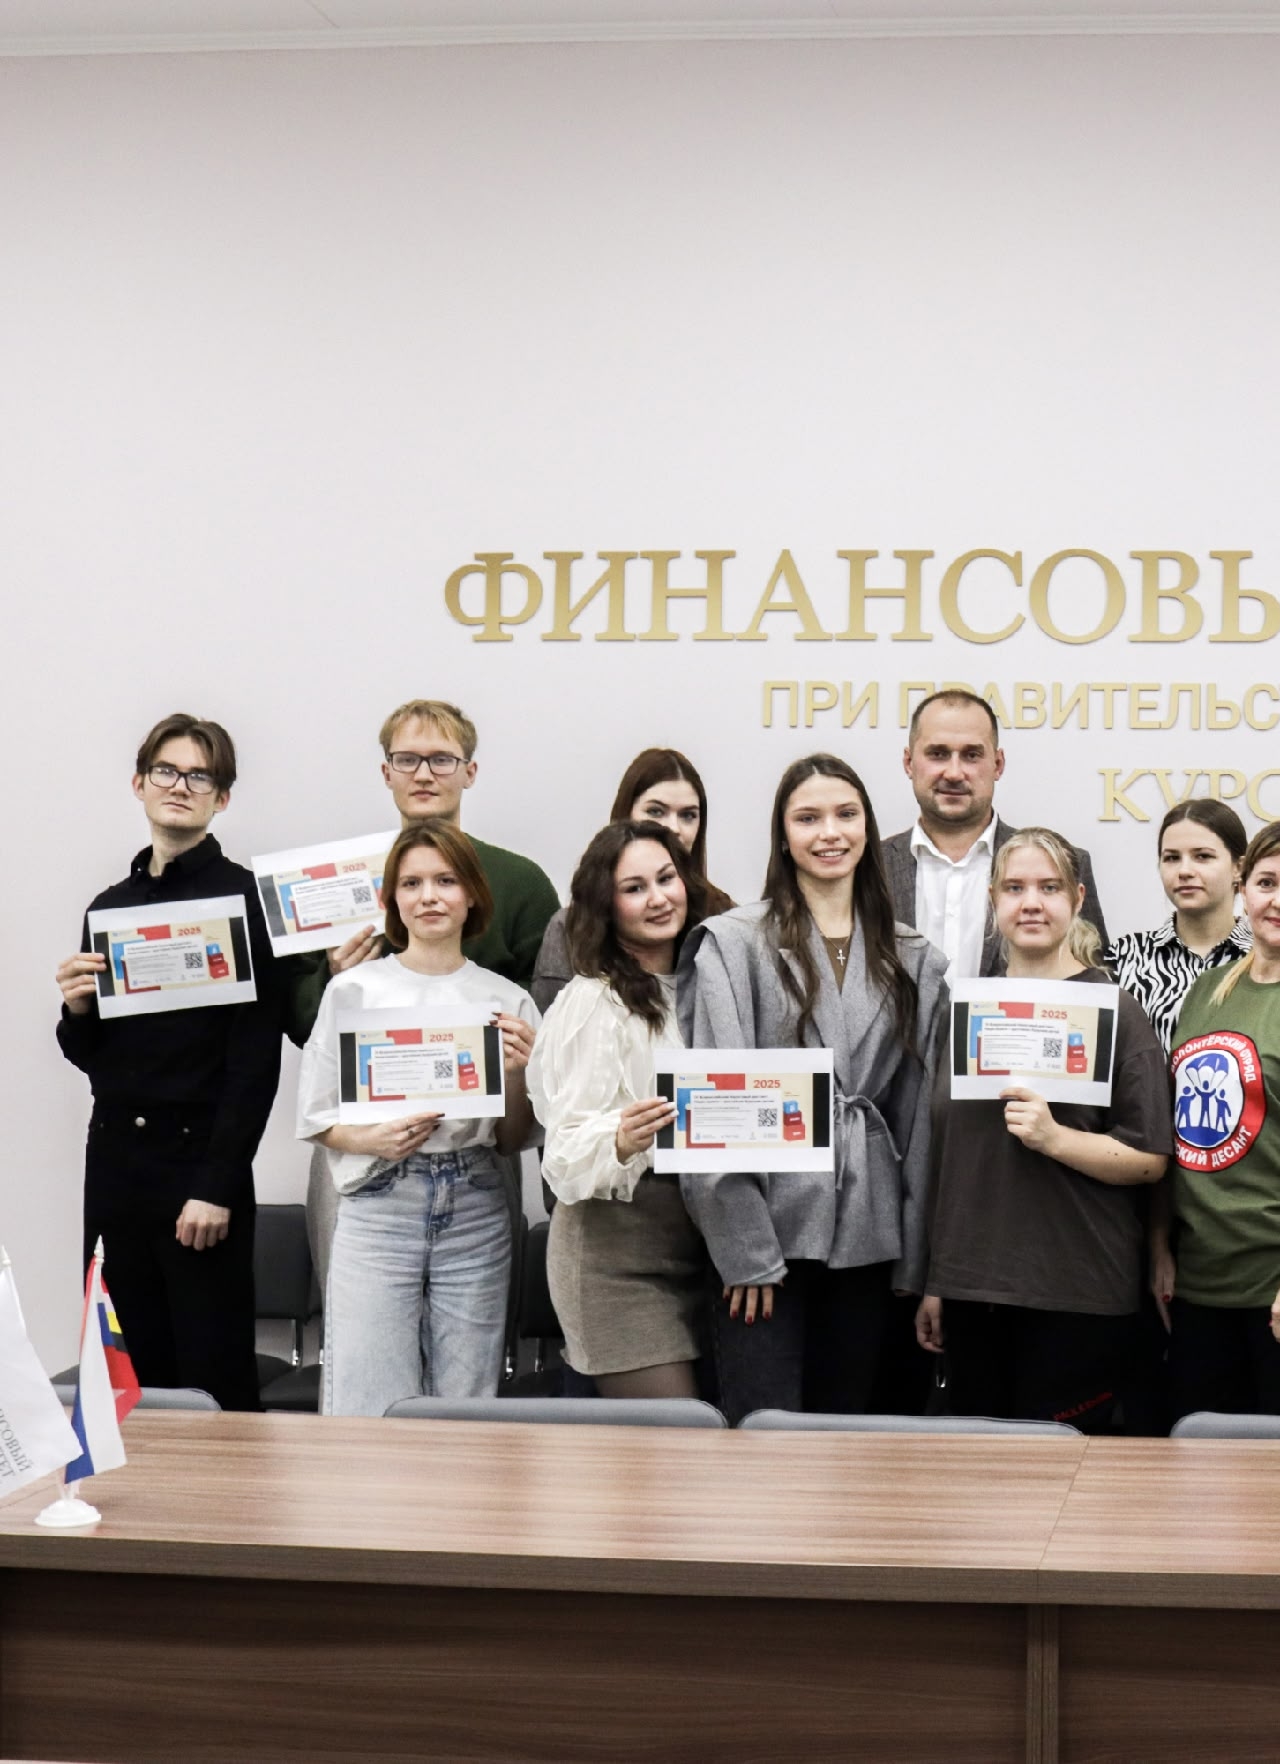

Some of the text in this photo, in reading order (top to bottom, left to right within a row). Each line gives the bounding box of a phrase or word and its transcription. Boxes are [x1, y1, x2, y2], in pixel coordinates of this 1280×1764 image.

[762, 681, 879, 729] ПРИ
[177, 926, 202, 937] 2025
[1041, 1009, 1068, 1020] 2025
[429, 1033, 454, 1043] 2025
[753, 1079, 781, 1089] 2025
[1211, 1125, 1252, 1168] ДЕСАНТ
